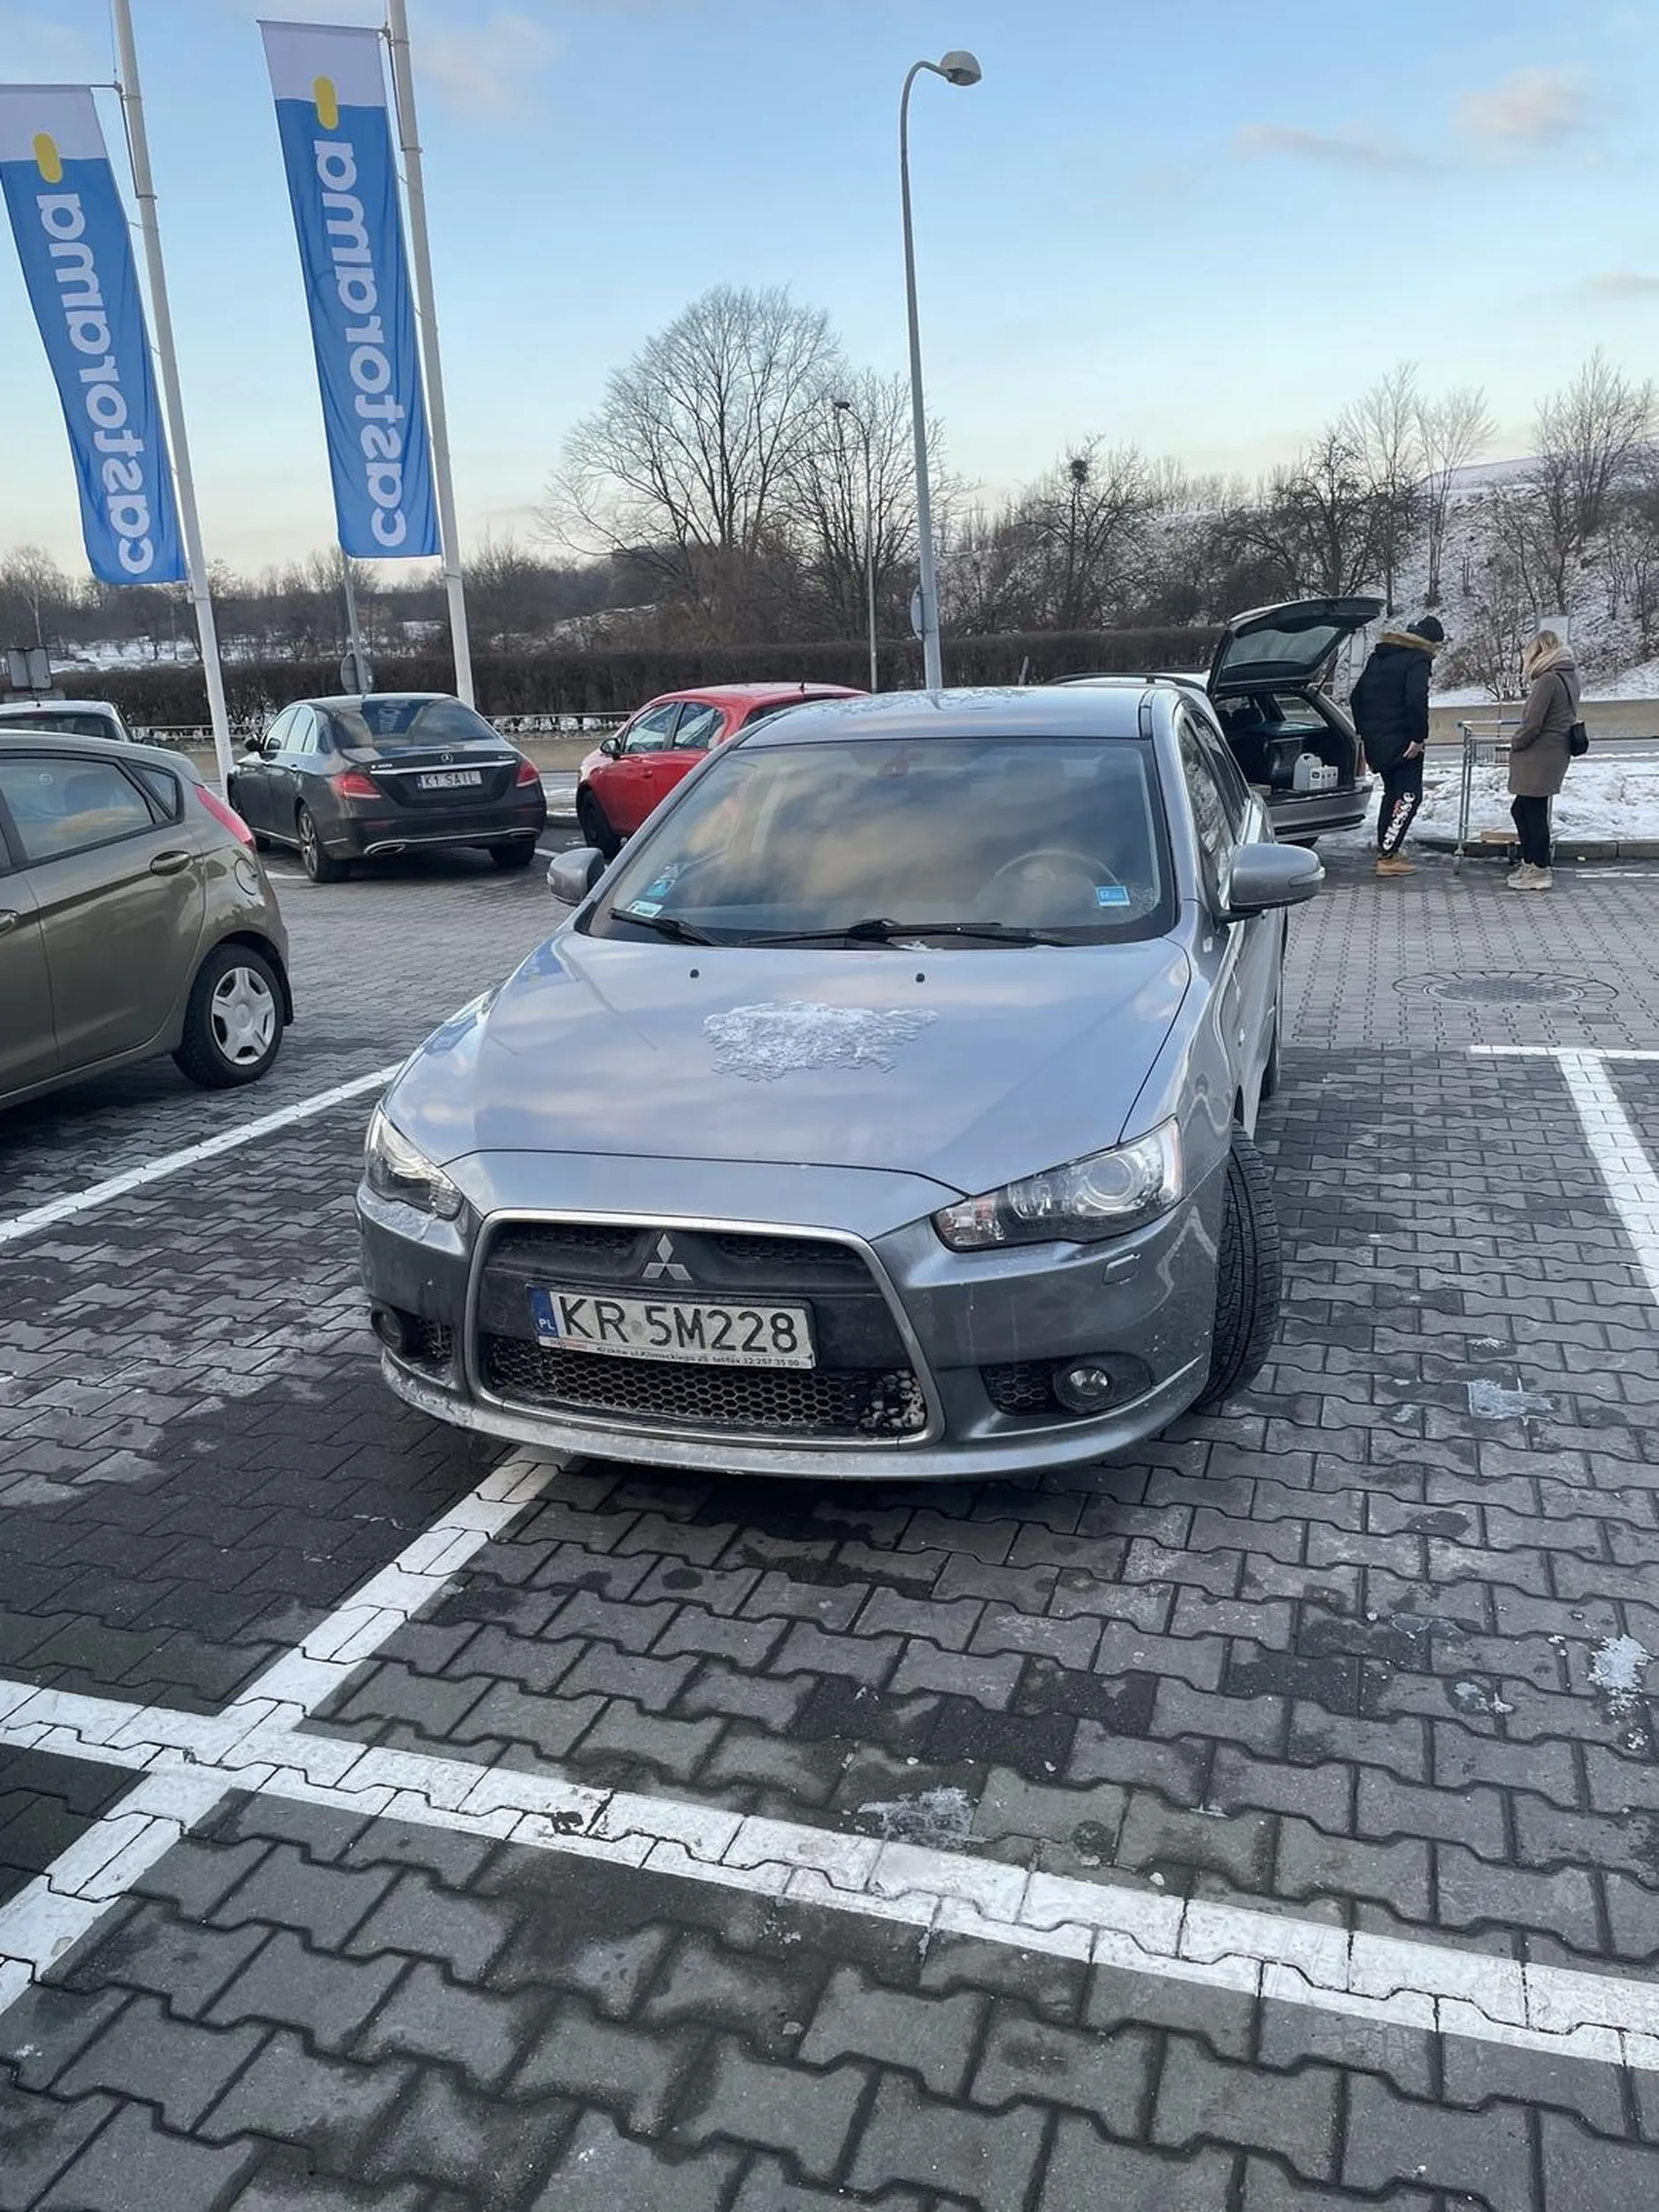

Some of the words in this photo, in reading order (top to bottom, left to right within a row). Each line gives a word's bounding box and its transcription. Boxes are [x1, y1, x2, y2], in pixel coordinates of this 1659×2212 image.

[1382, 791, 1416, 850] ellesse
[539, 1317, 555, 1330] PL
[558, 1295, 629, 1343] KR
[644, 1305, 797, 1354] 5M228
